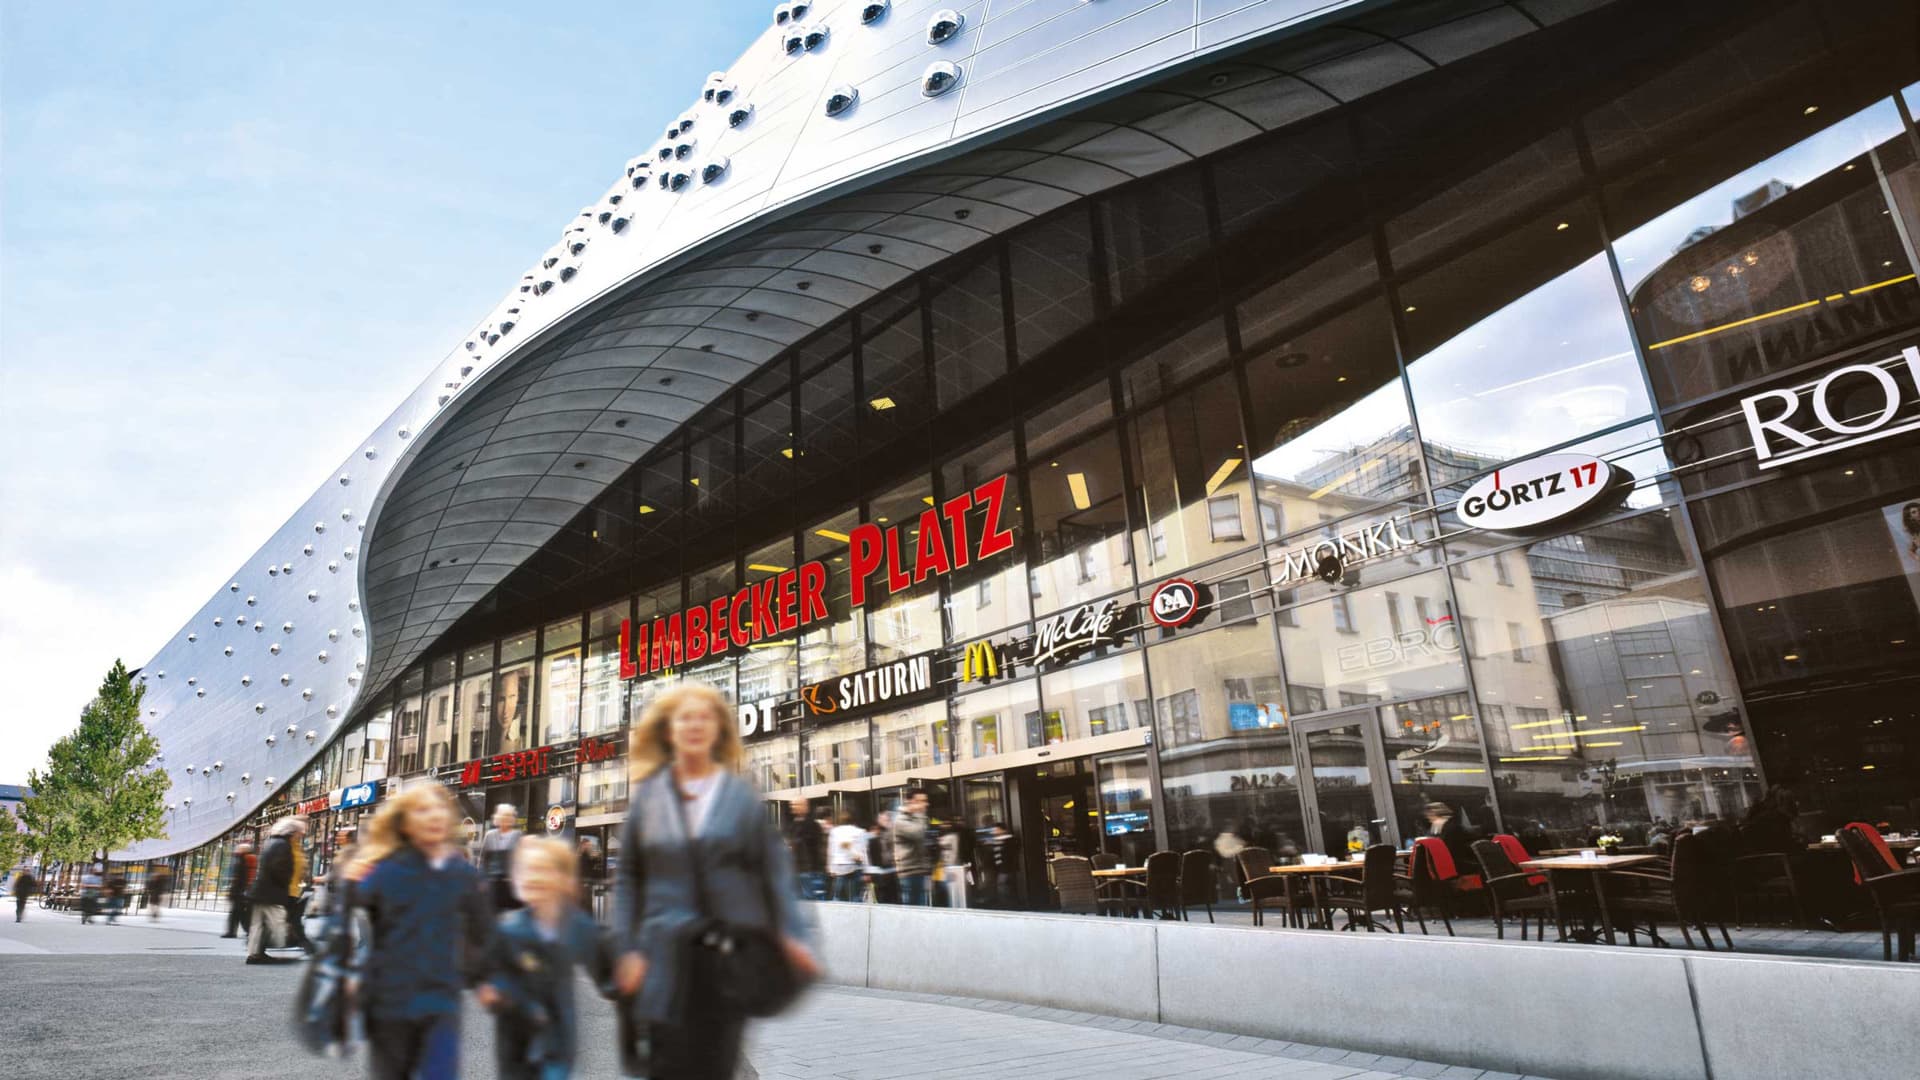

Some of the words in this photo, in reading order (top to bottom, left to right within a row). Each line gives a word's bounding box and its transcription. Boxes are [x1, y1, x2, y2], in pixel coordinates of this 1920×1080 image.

[1569, 461, 1598, 489] 17
[618, 560, 829, 681] LIMBECKER
[849, 473, 1014, 607] PLATZ
[1033, 599, 1114, 660] McCafé
[839, 656, 931, 710] SATURN
[738, 697, 776, 738] DT
[492, 746, 552, 783] ESPRIT
